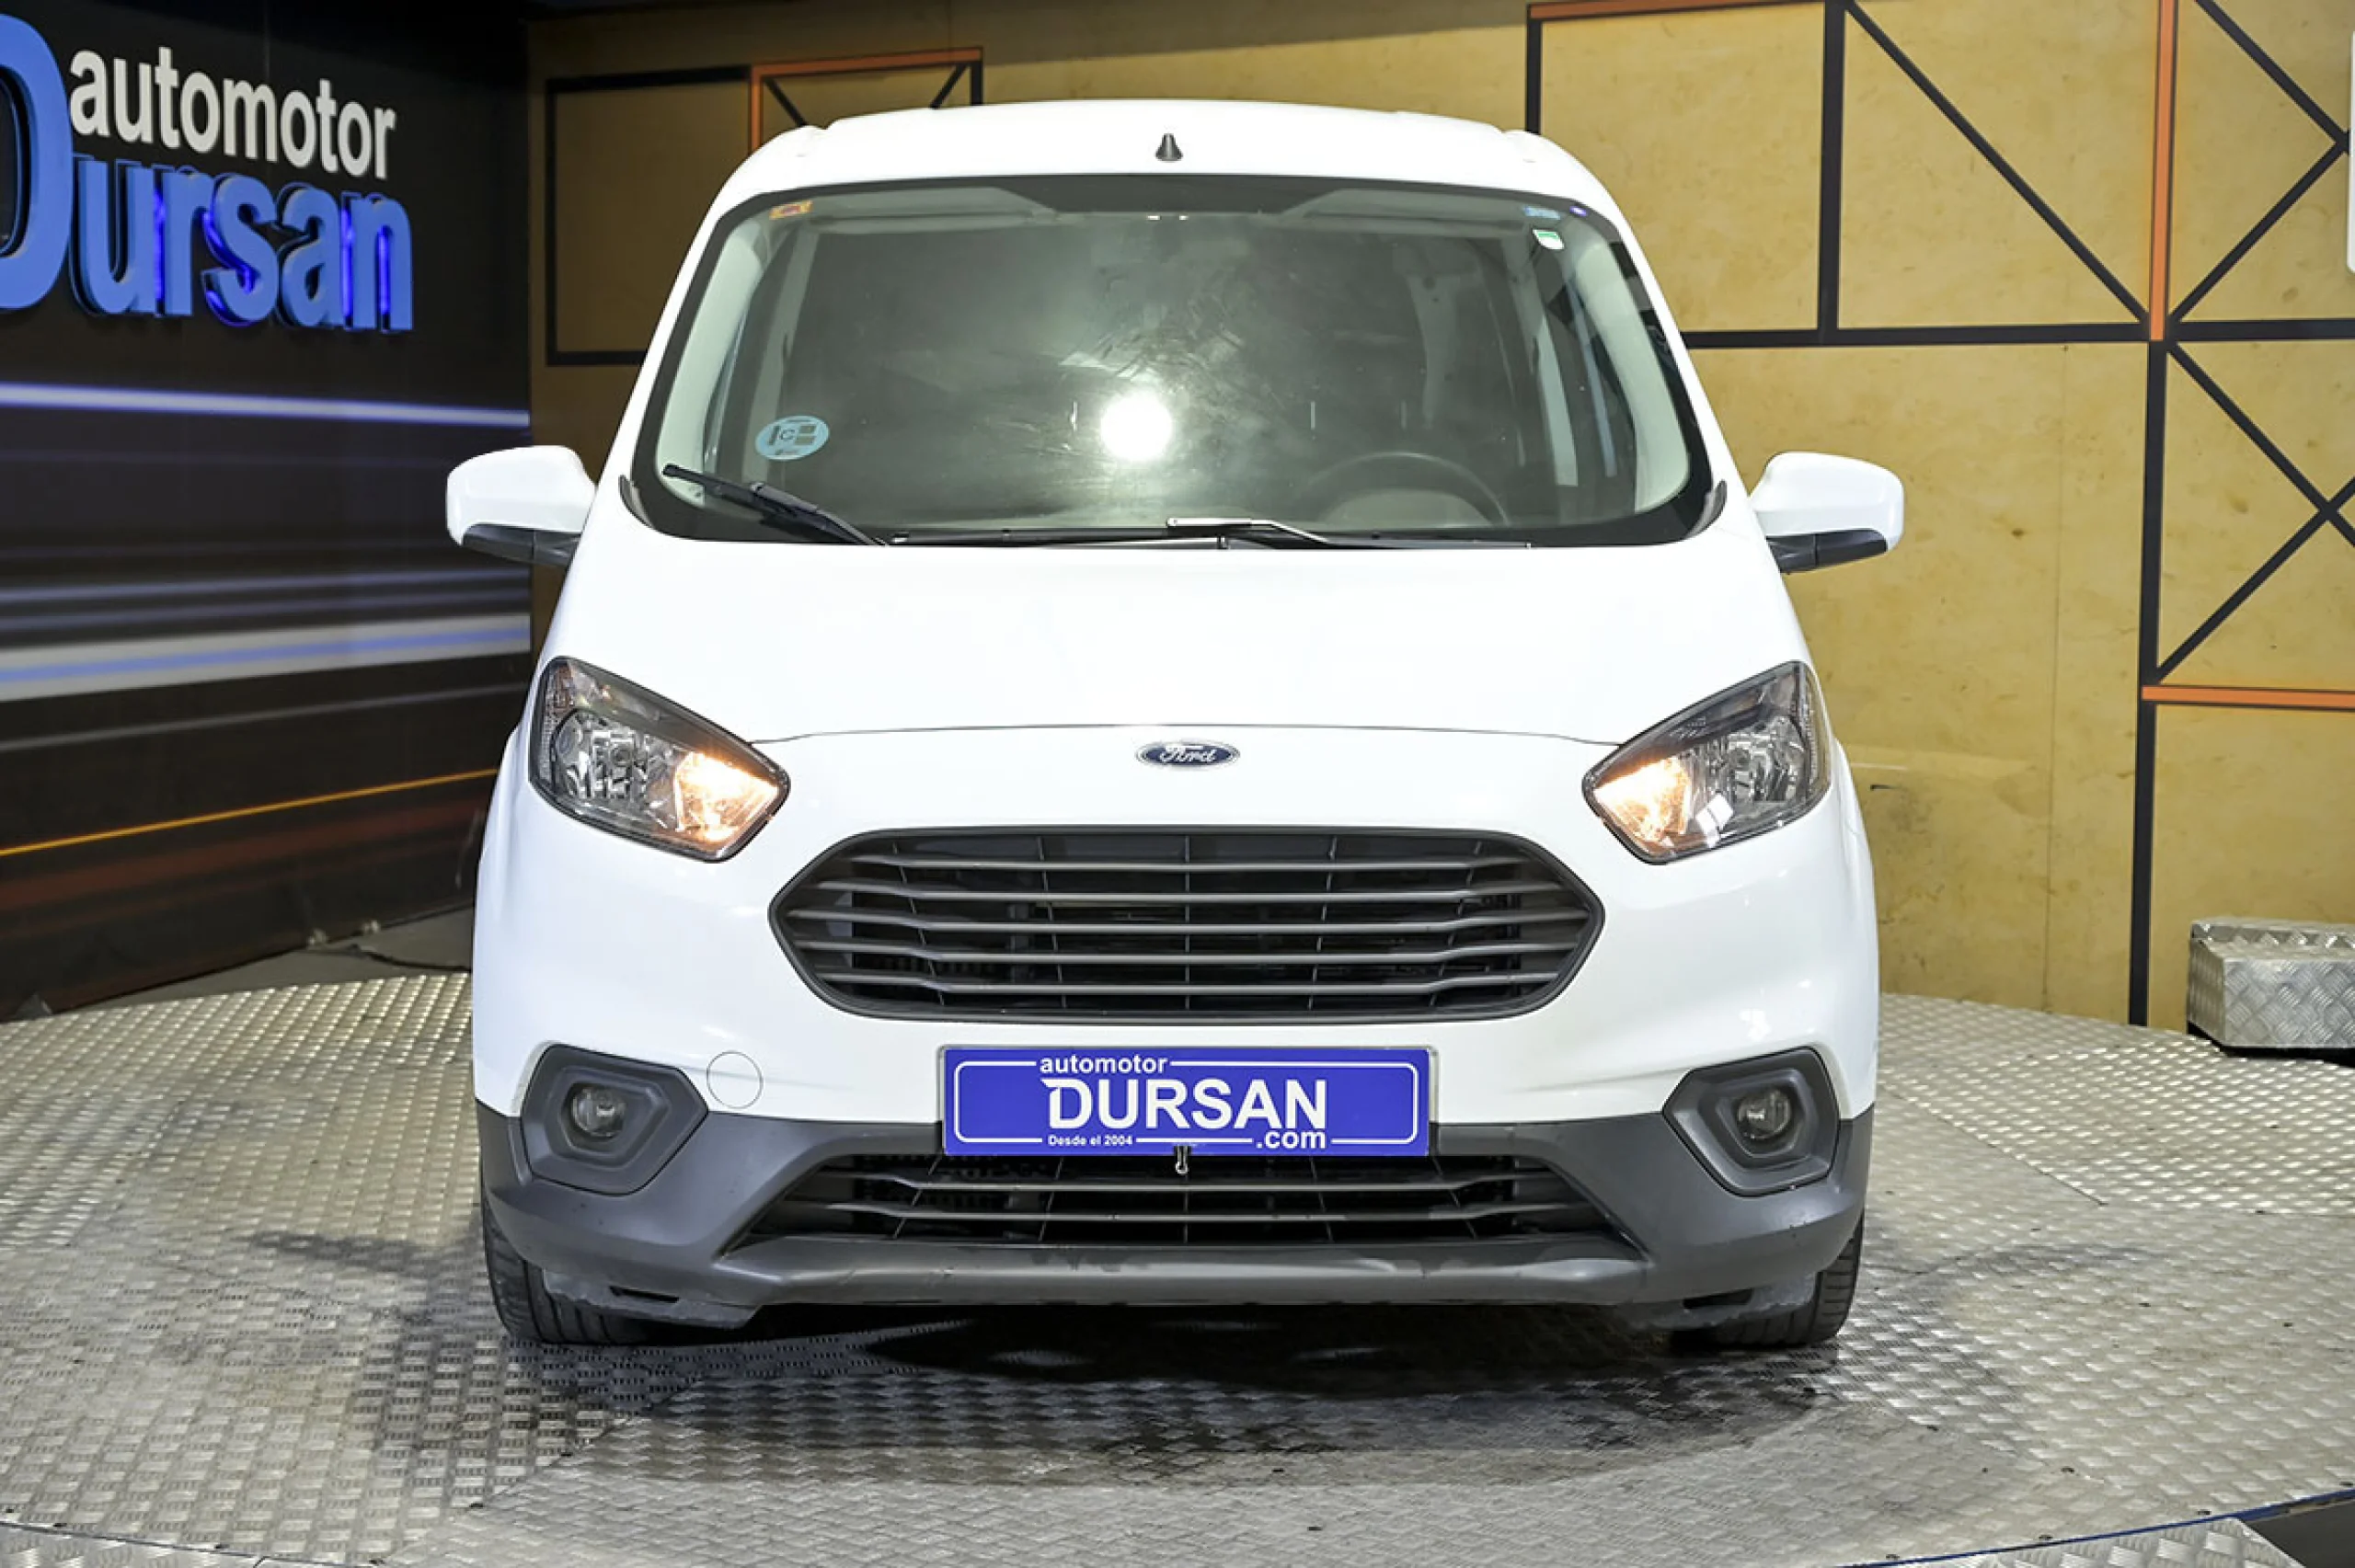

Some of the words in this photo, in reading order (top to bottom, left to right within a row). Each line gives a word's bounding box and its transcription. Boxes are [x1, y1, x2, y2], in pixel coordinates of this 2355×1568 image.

[70, 47, 396, 179] automotor
[1159, 745, 1217, 762] Ford
[1040, 1054, 1168, 1074] automotor
[1040, 1078, 1327, 1129] DURSAN
[1048, 1135, 1086, 1146] Desde
[1090, 1135, 1102, 1146] el
[1104, 1135, 1133, 1146] 2004
[1256, 1130, 1327, 1150] .com
